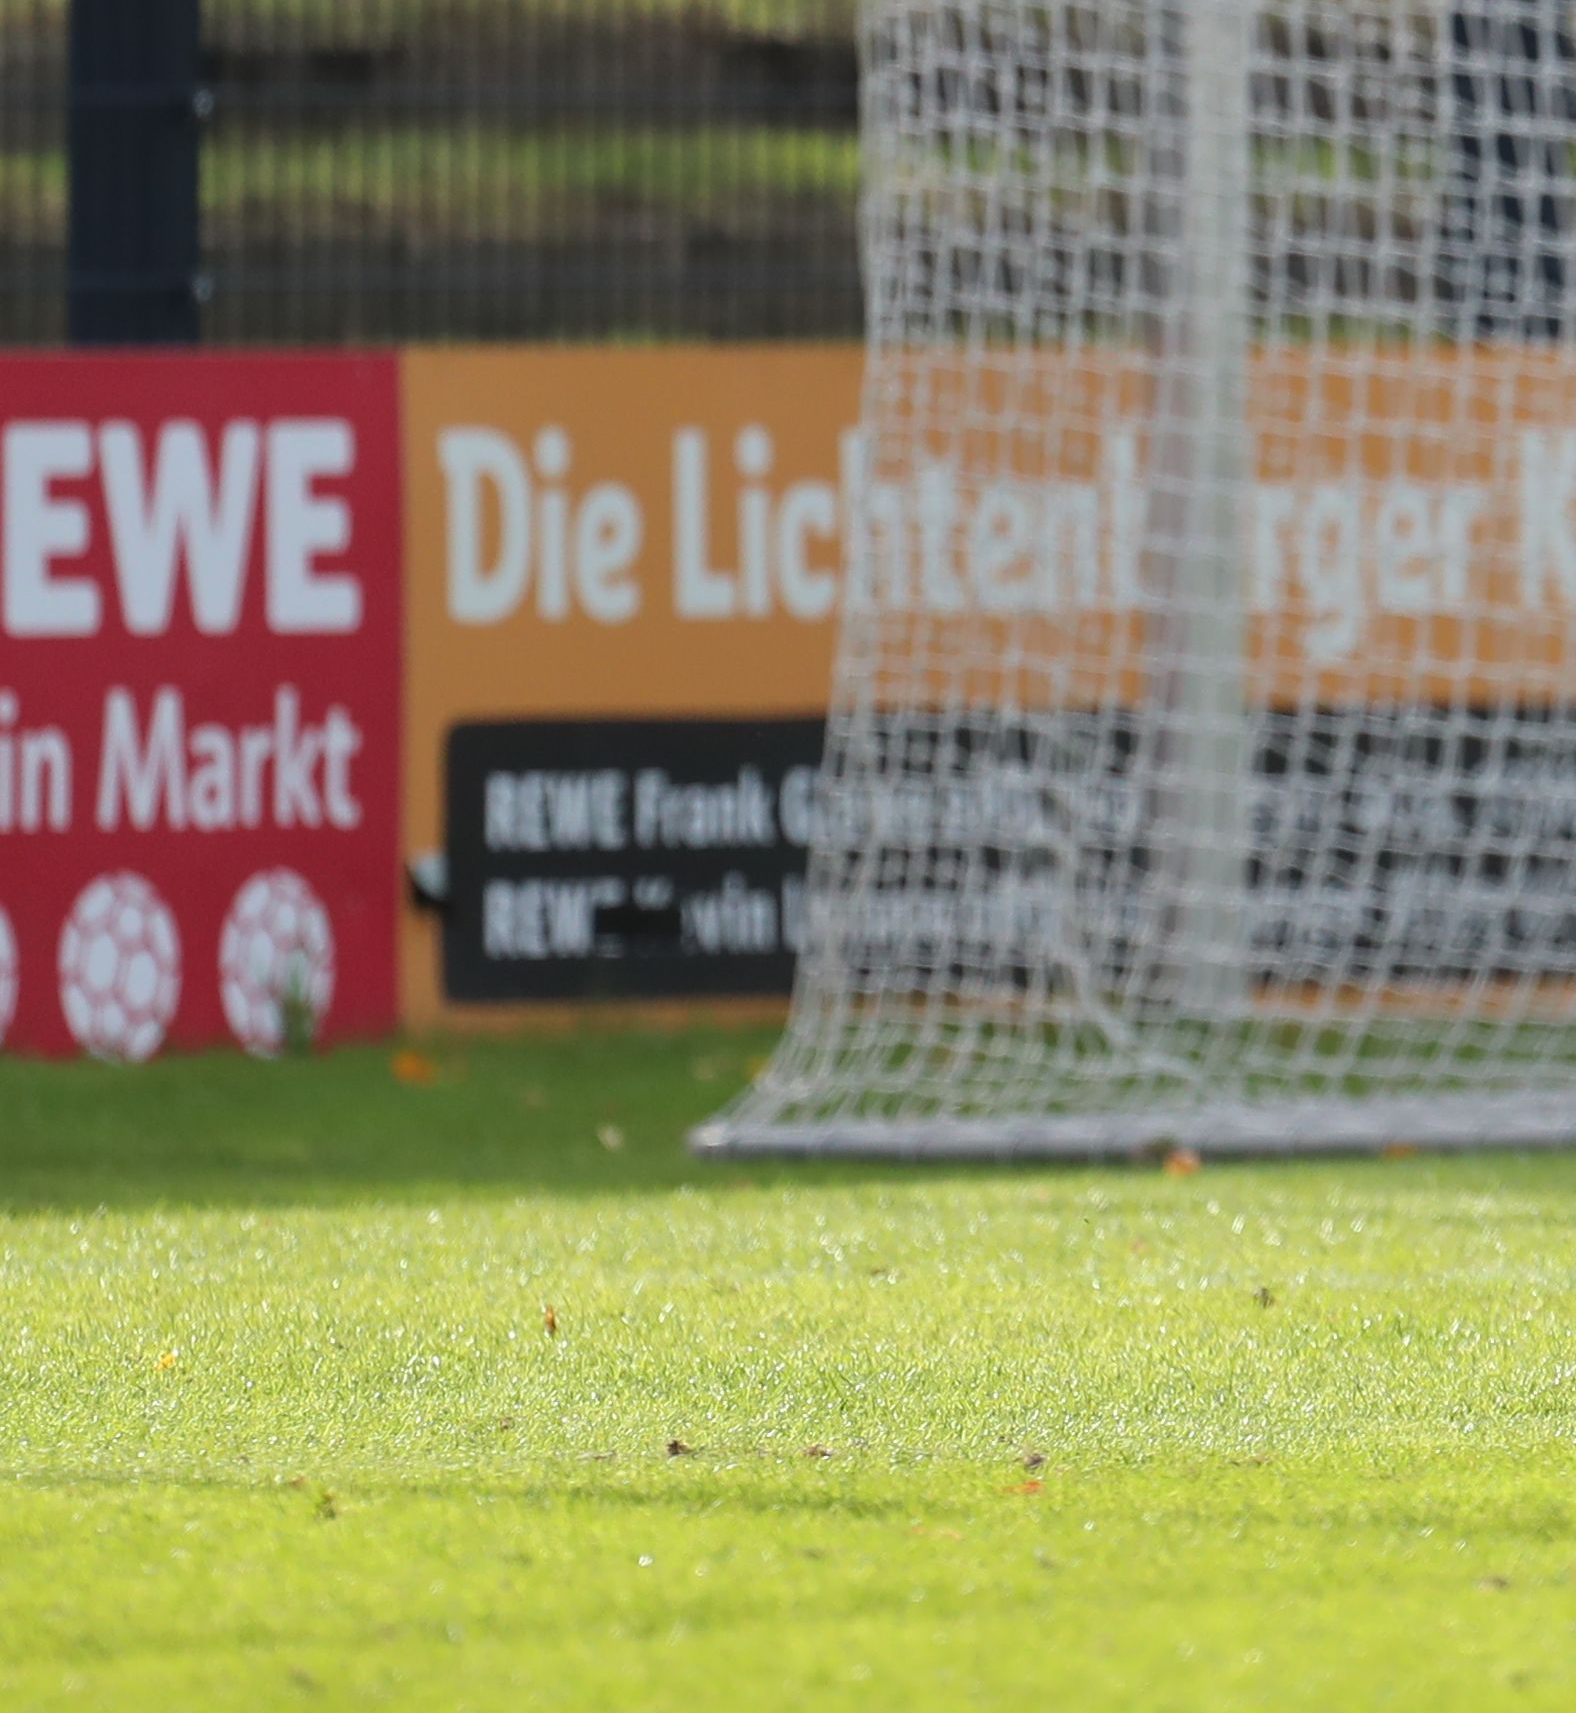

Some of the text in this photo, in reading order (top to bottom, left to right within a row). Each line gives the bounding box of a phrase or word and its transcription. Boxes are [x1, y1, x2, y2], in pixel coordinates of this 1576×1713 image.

[436, 425, 643, 625] Die
[95, 682, 364, 833] Markt
[483, 768, 624, 853] REWE
[633, 762, 775, 850] Frank
